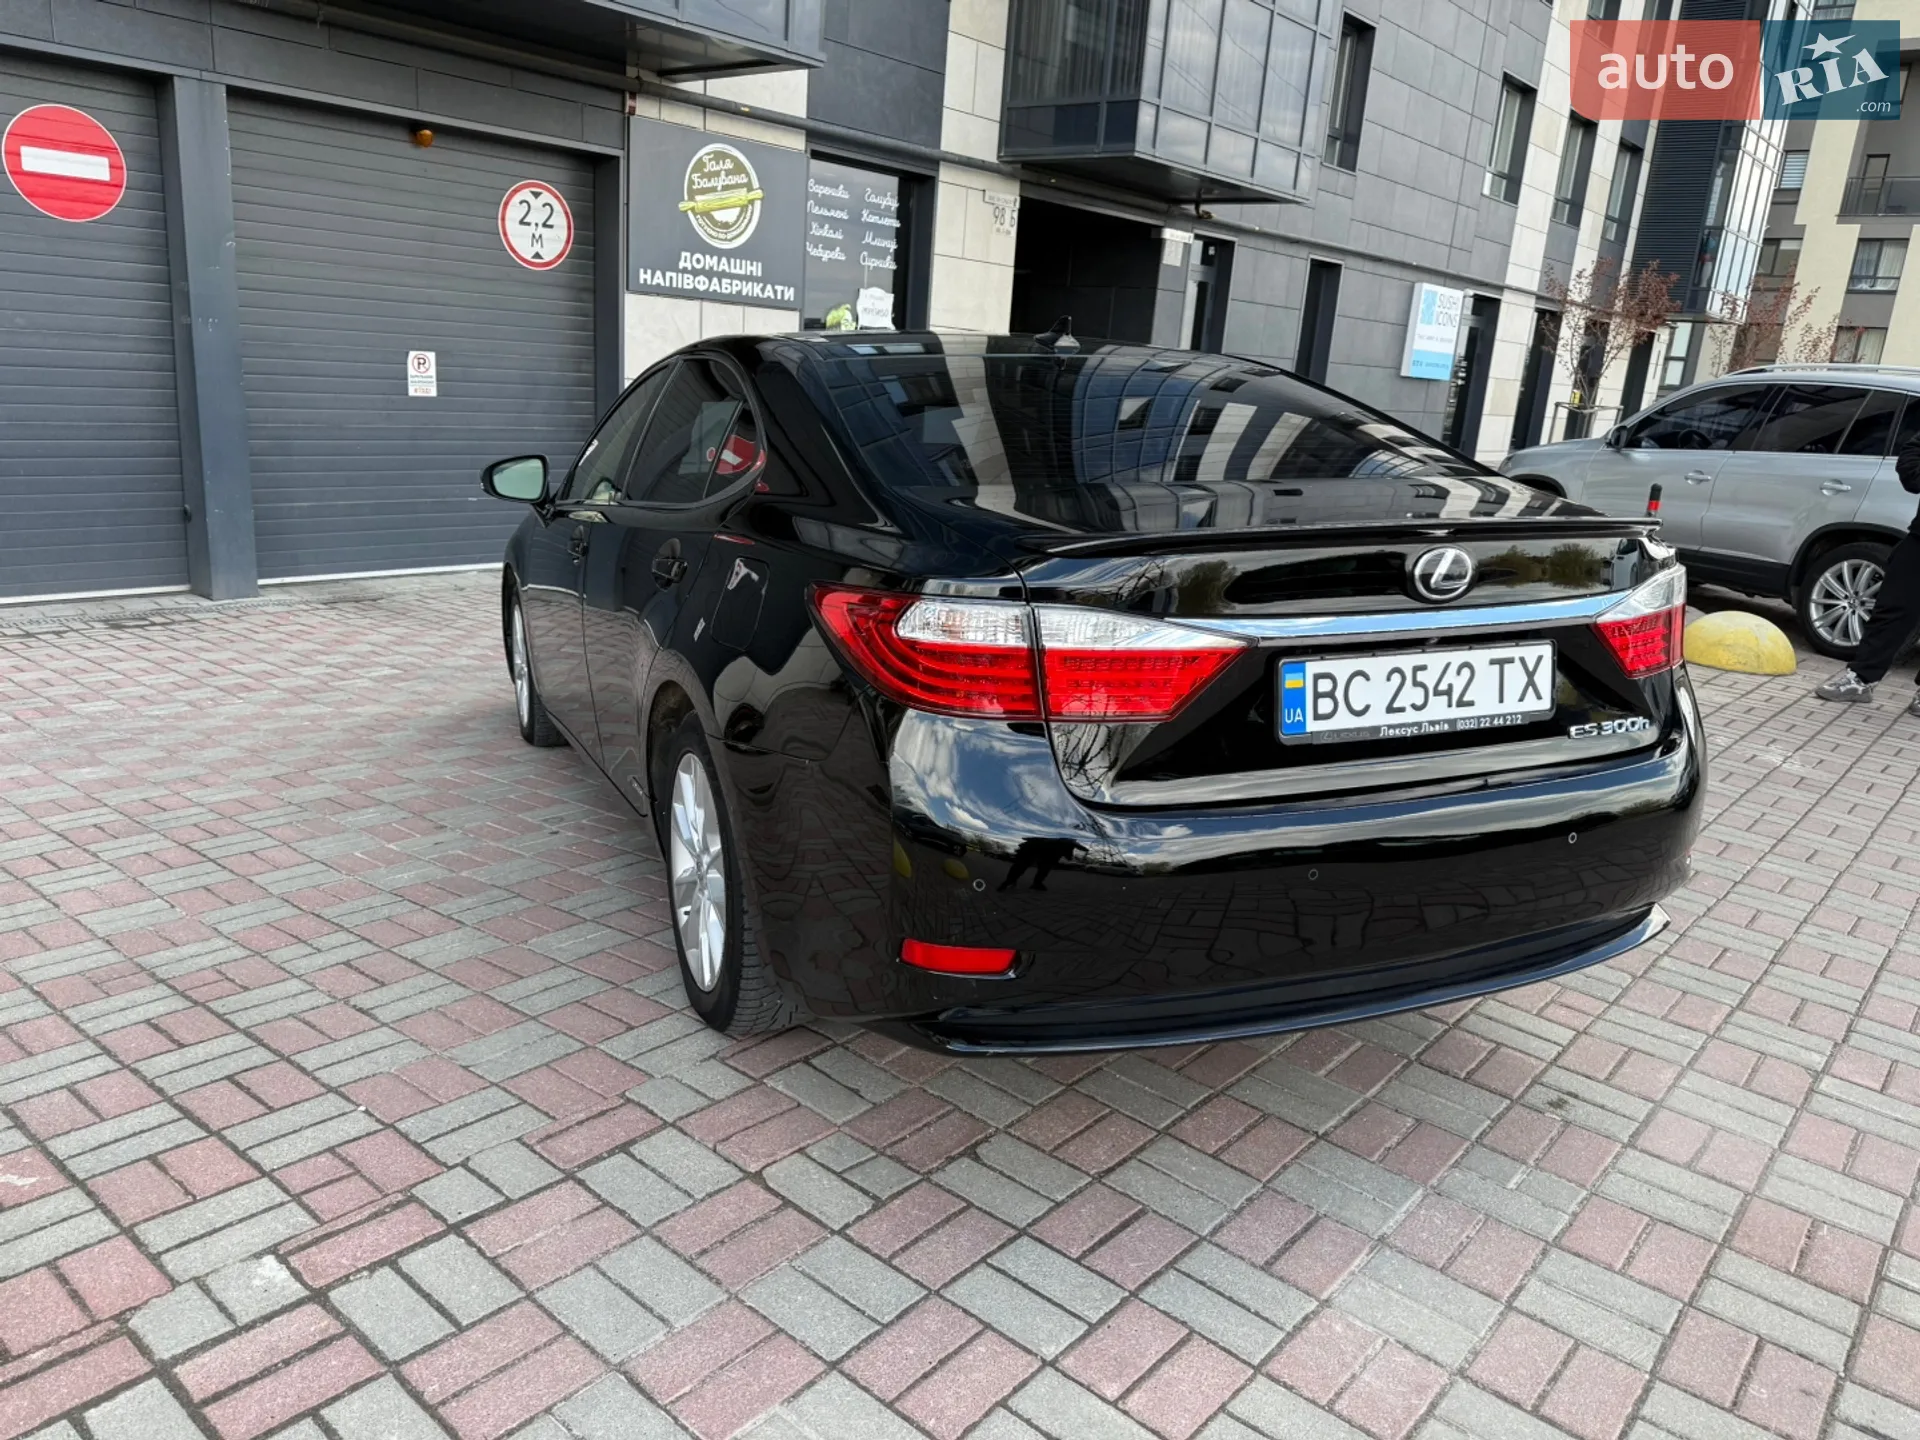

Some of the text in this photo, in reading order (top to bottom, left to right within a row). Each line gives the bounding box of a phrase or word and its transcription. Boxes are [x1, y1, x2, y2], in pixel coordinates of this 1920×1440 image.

[702, 154, 734, 172] Галя
[691, 171, 748, 191] Балувана
[808, 178, 899, 211] Вареники Голубці
[518, 199, 555, 231] 2,2
[807, 200, 901, 227] Пельмені Котлети
[993, 206, 1006, 226] 98
[809, 221, 898, 252] Хінкалі Млинці
[678, 251, 762, 277] ДОМАШНІ
[806, 241, 897, 270] Чебуреки Сирники
[639, 268, 795, 301] НАПІВФАБРИКАТИ
[1285, 654, 1544, 724] UA BC 2542 TX
[1380, 725, 1418, 737] Лексус
[1420, 721, 1449, 734] Львів
[1456, 717, 1478, 730] (032)
[1479, 717, 1491, 727] 22
[1493, 715, 1505, 726] 44
[1506, 714, 1522, 725] 212
[1569, 716, 1650, 739] ES 300h
